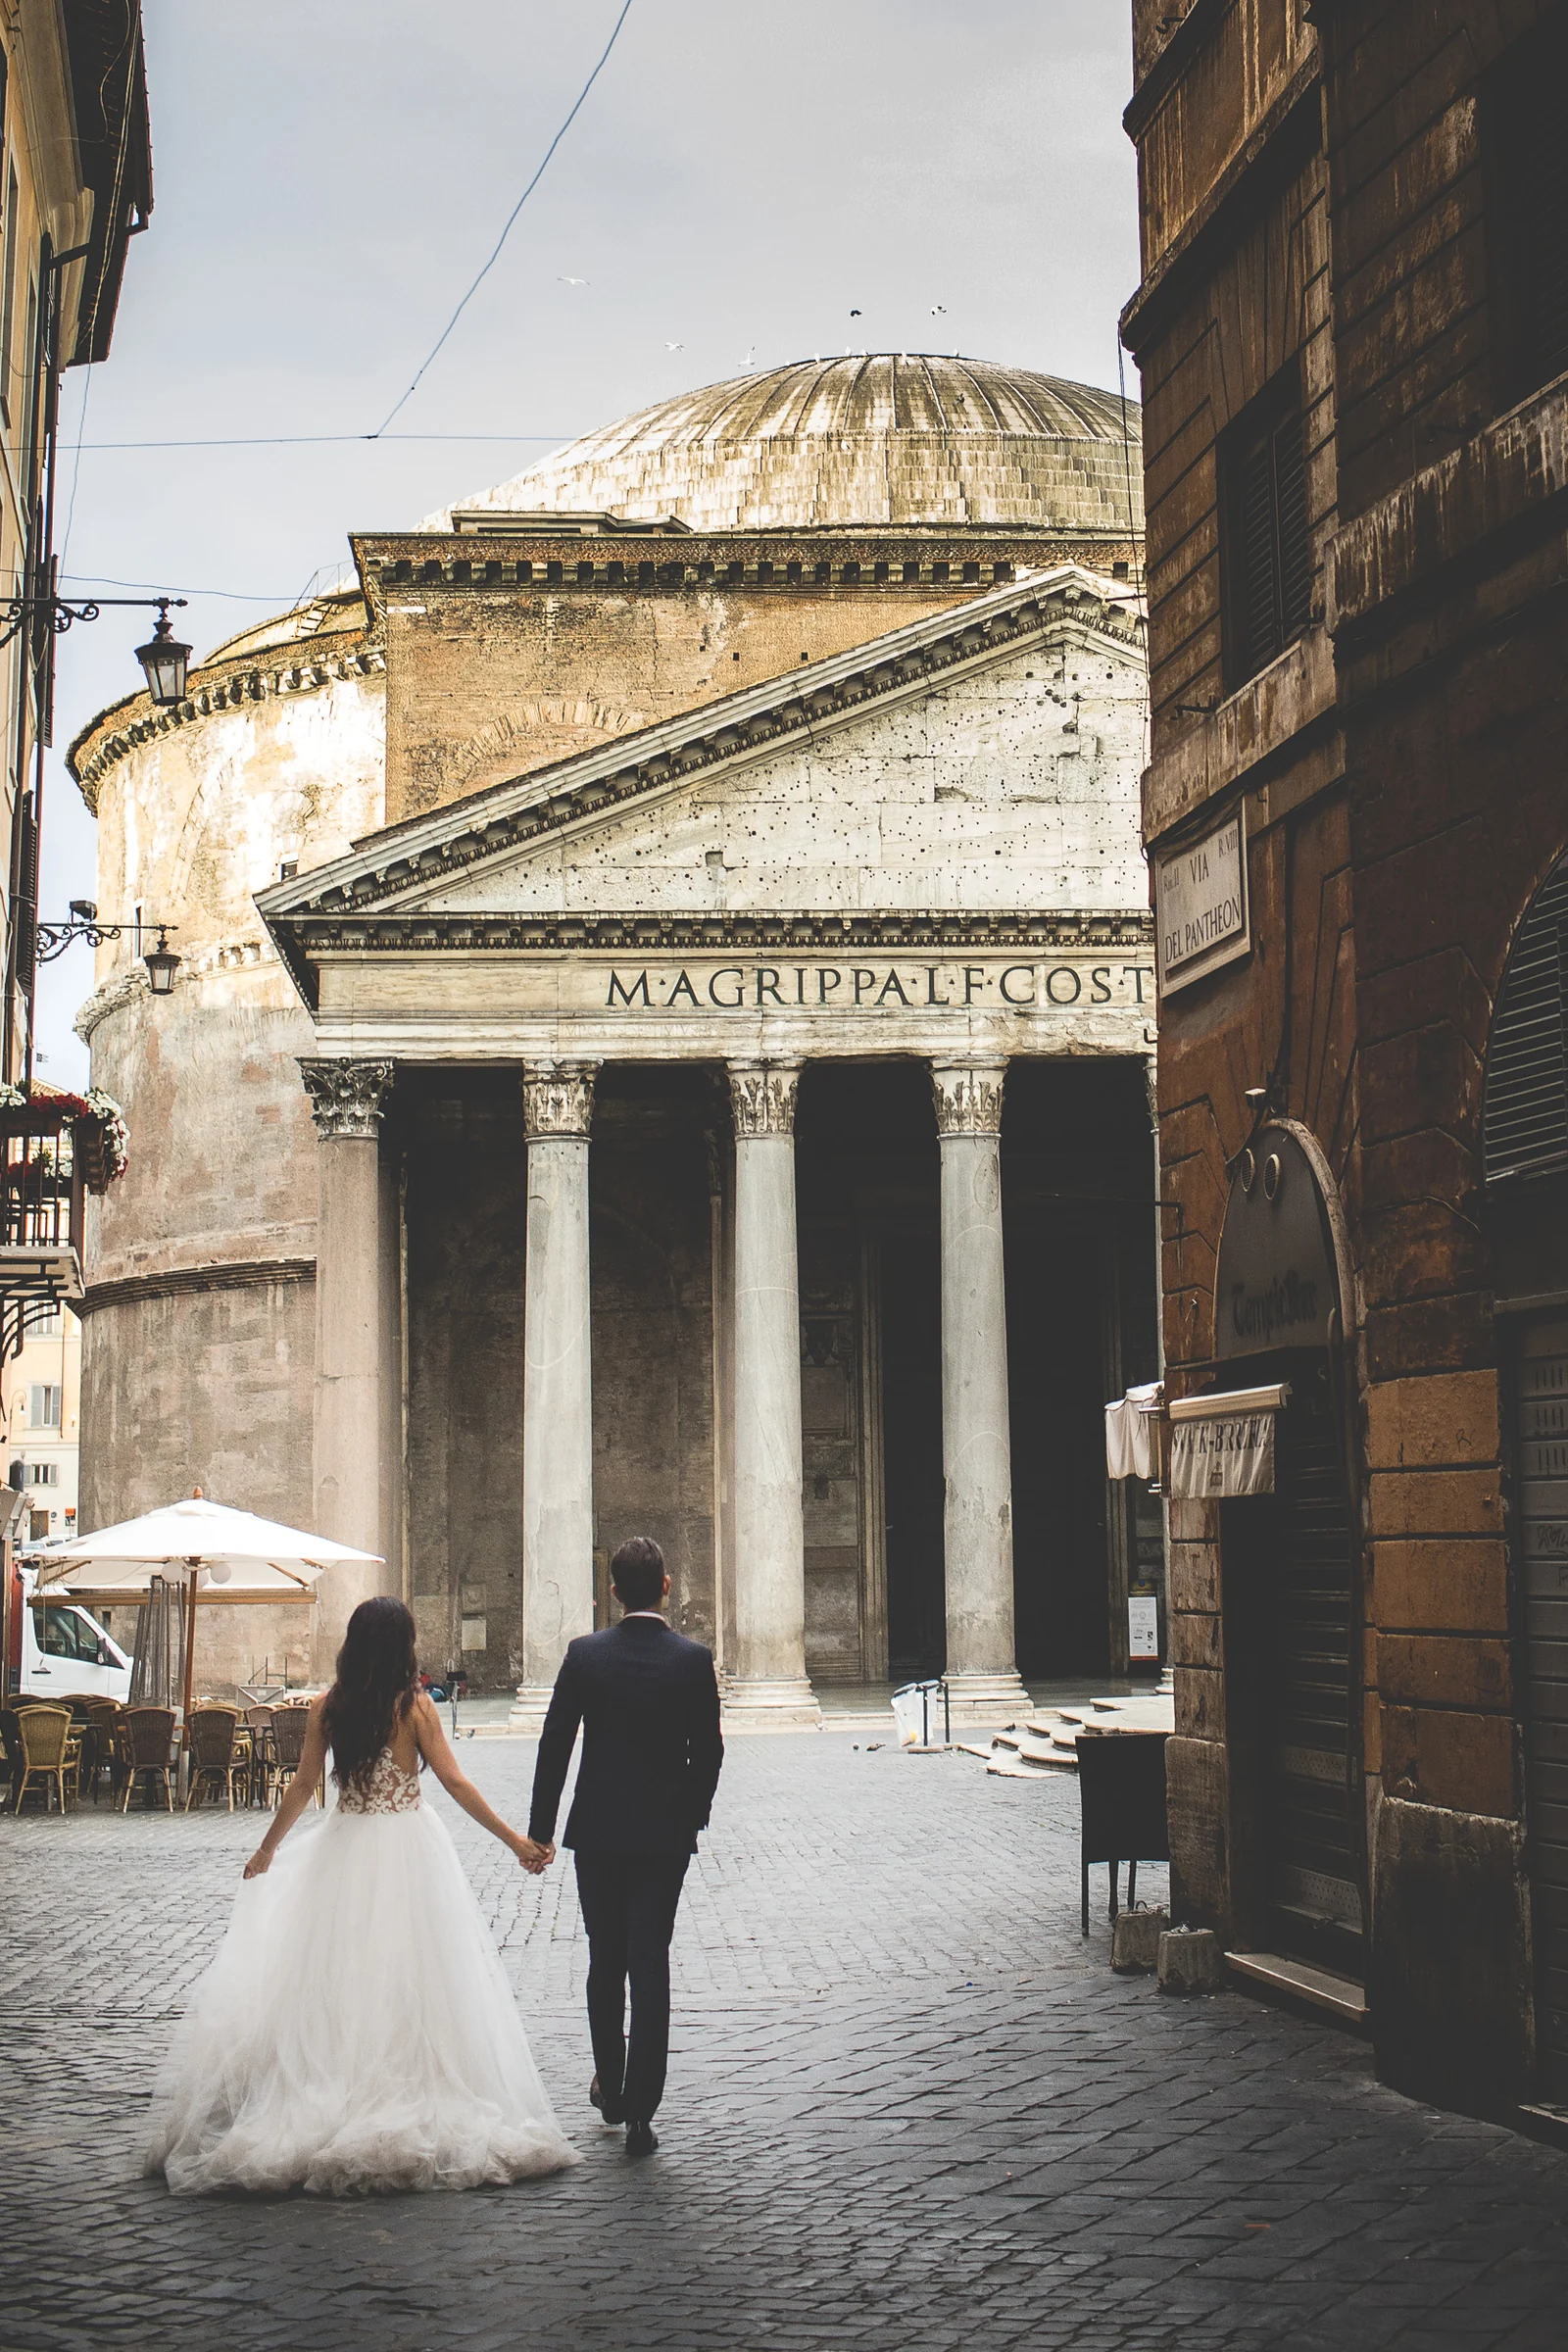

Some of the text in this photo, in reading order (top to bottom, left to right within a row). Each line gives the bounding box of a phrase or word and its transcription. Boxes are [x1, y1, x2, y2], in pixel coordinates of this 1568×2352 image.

[1190, 853, 1209, 884] VIA
[1165, 894, 1240, 963] DEL PANTHEON
